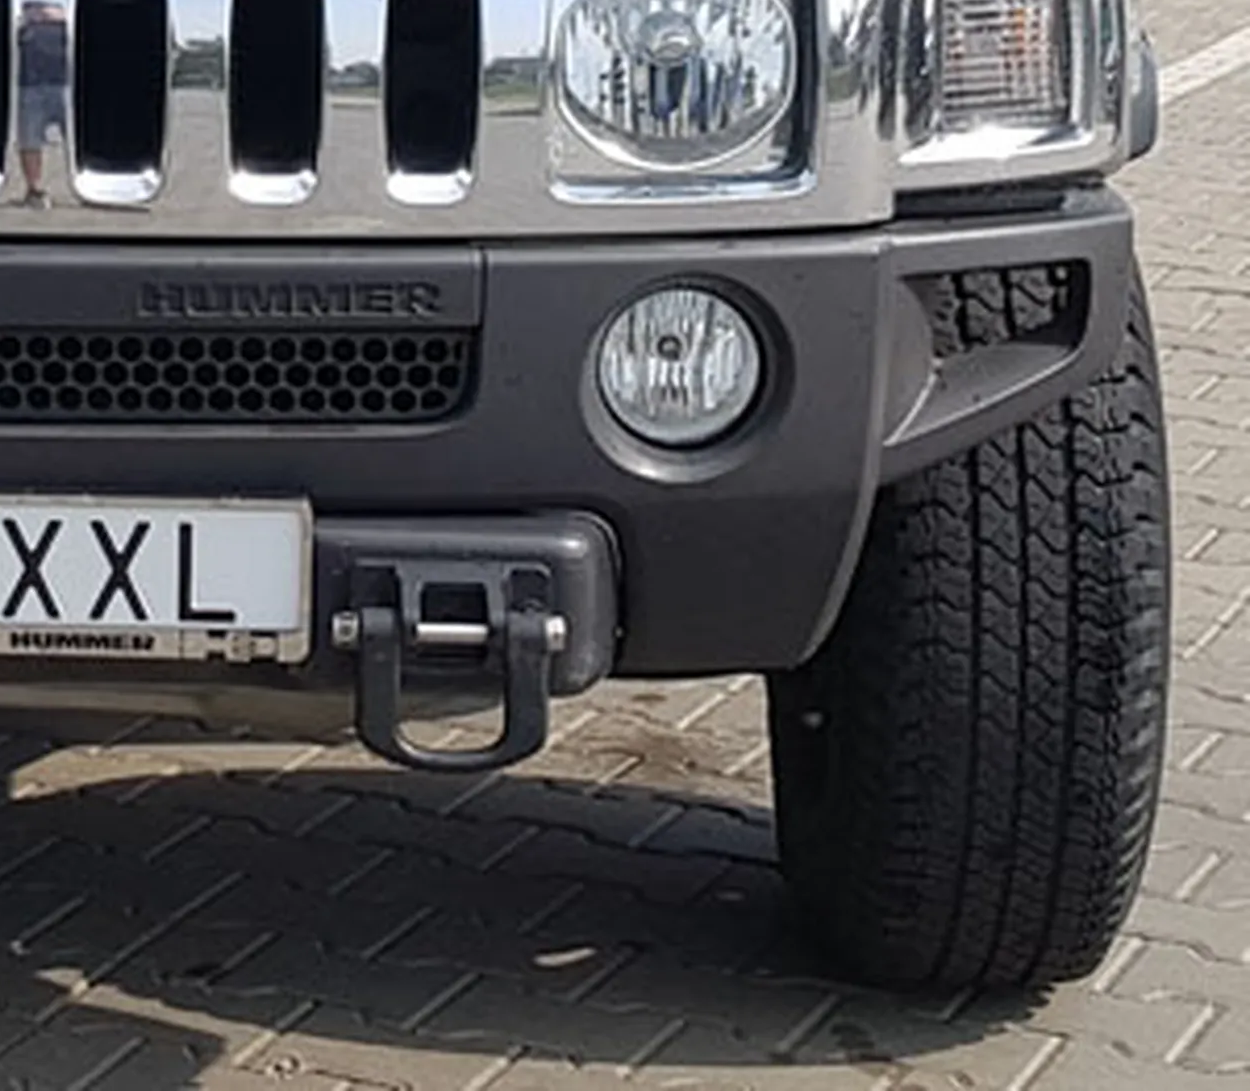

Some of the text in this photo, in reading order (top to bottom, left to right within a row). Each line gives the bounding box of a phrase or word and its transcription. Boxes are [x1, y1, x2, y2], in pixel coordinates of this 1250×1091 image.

[136, 281, 441, 319] HUMMER
[0, 518, 237, 623] XXL
[8, 631, 156, 651] HUMMER
